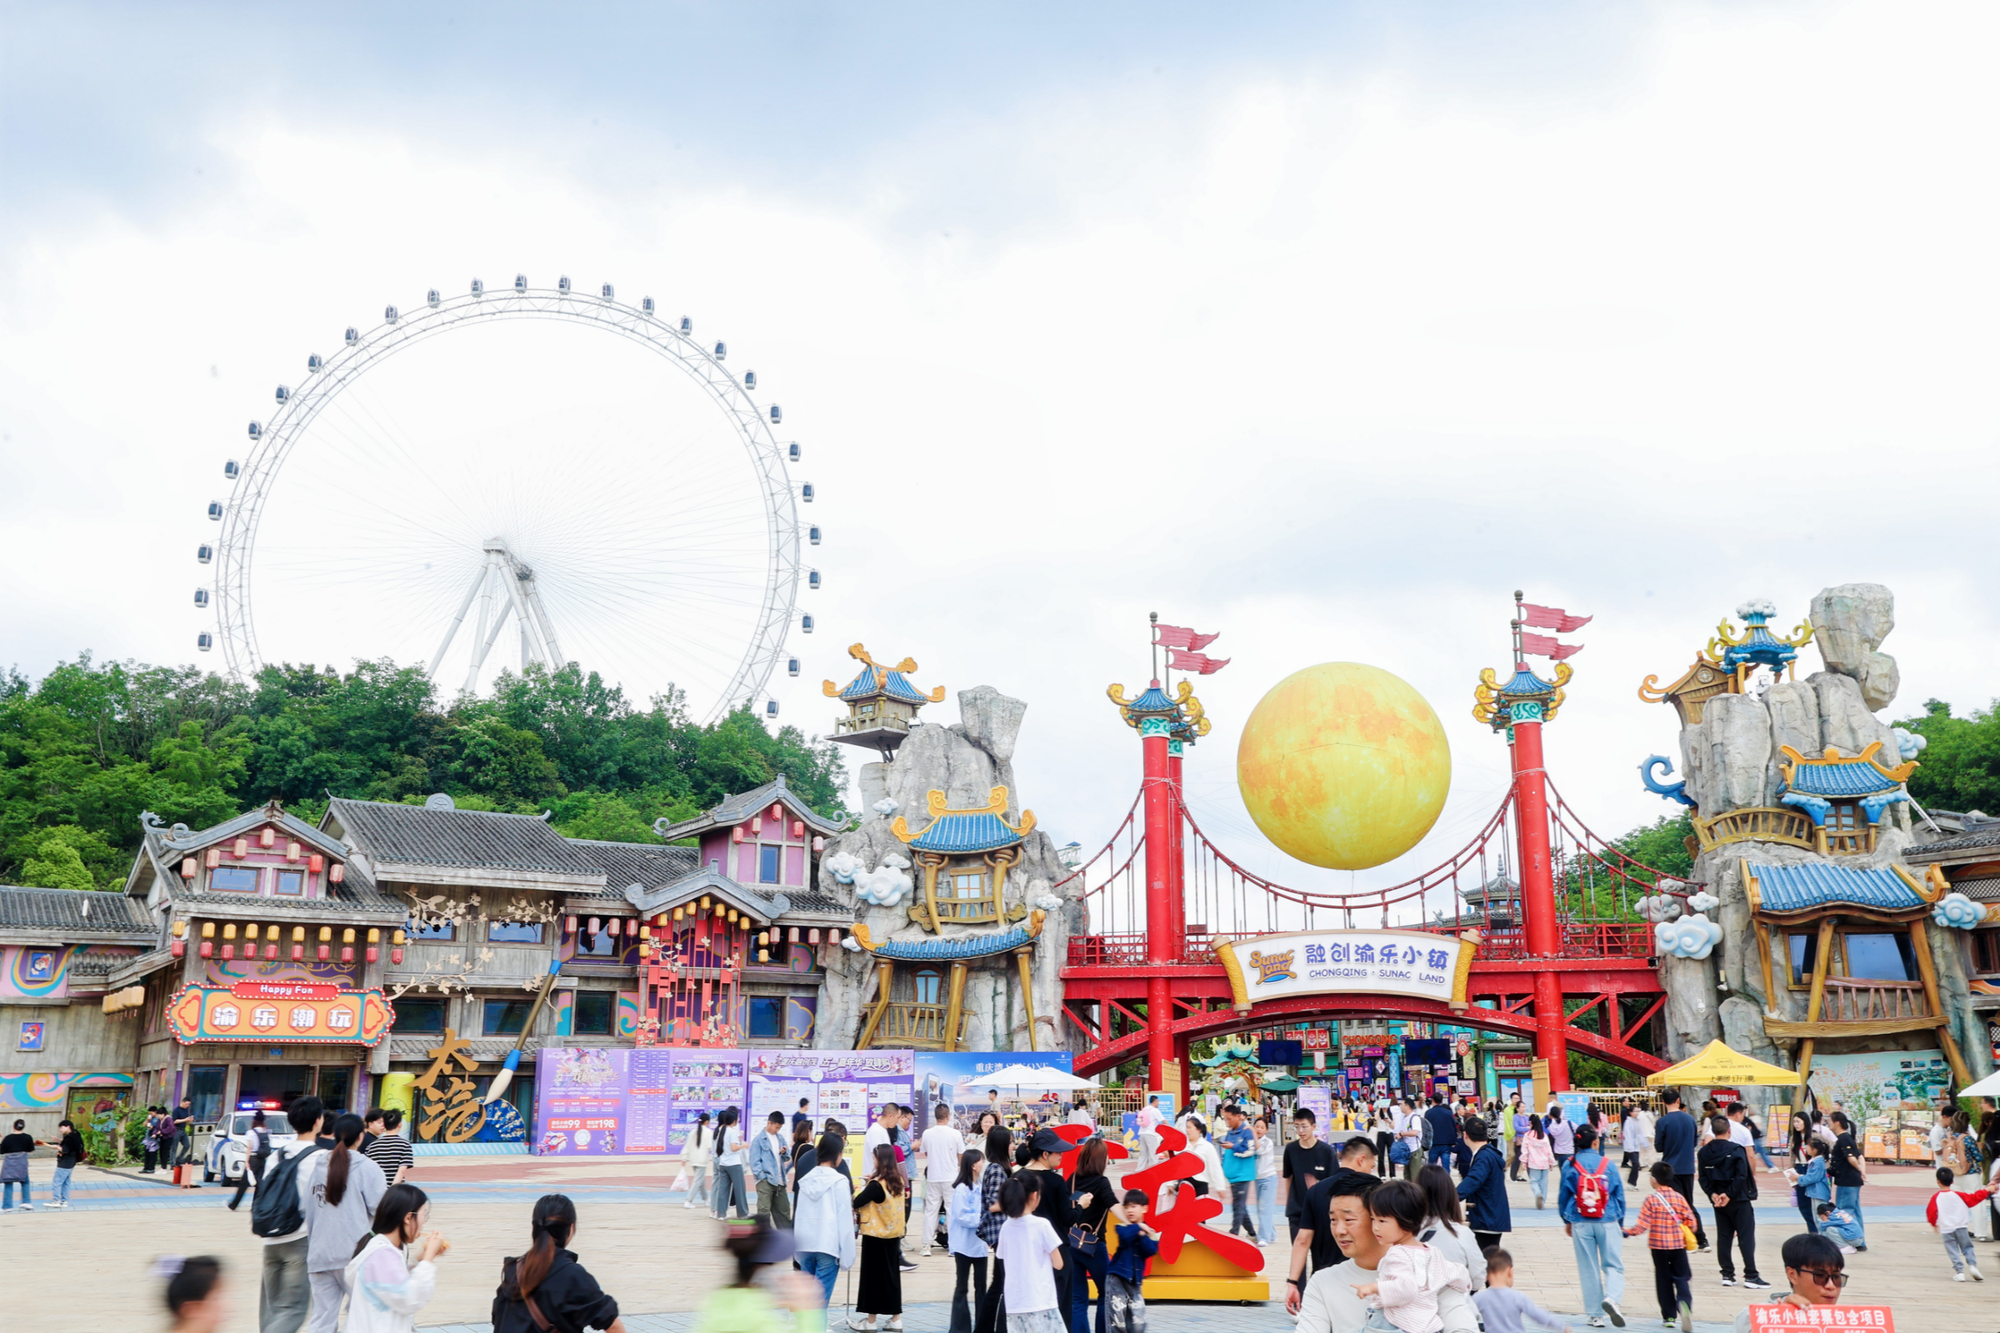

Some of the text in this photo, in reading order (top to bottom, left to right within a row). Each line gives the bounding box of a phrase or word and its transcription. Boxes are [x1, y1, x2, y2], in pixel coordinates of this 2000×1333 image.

[1250, 949, 1295, 969] Sunac
[1305, 942, 1450, 970] 融创渝乐小镇
[1256, 961, 1297, 985] Land
[1309, 968, 1446, 985] CHONGQING SUNAC LAND
[260, 985, 314, 995] Happy Fun
[213, 1006, 353, 1028] 渝乐潮玩
[1342, 1034, 1399, 1047] CHONGQING
[1755, 1307, 1886, 1326] 渝乐小镇套票包含项目
